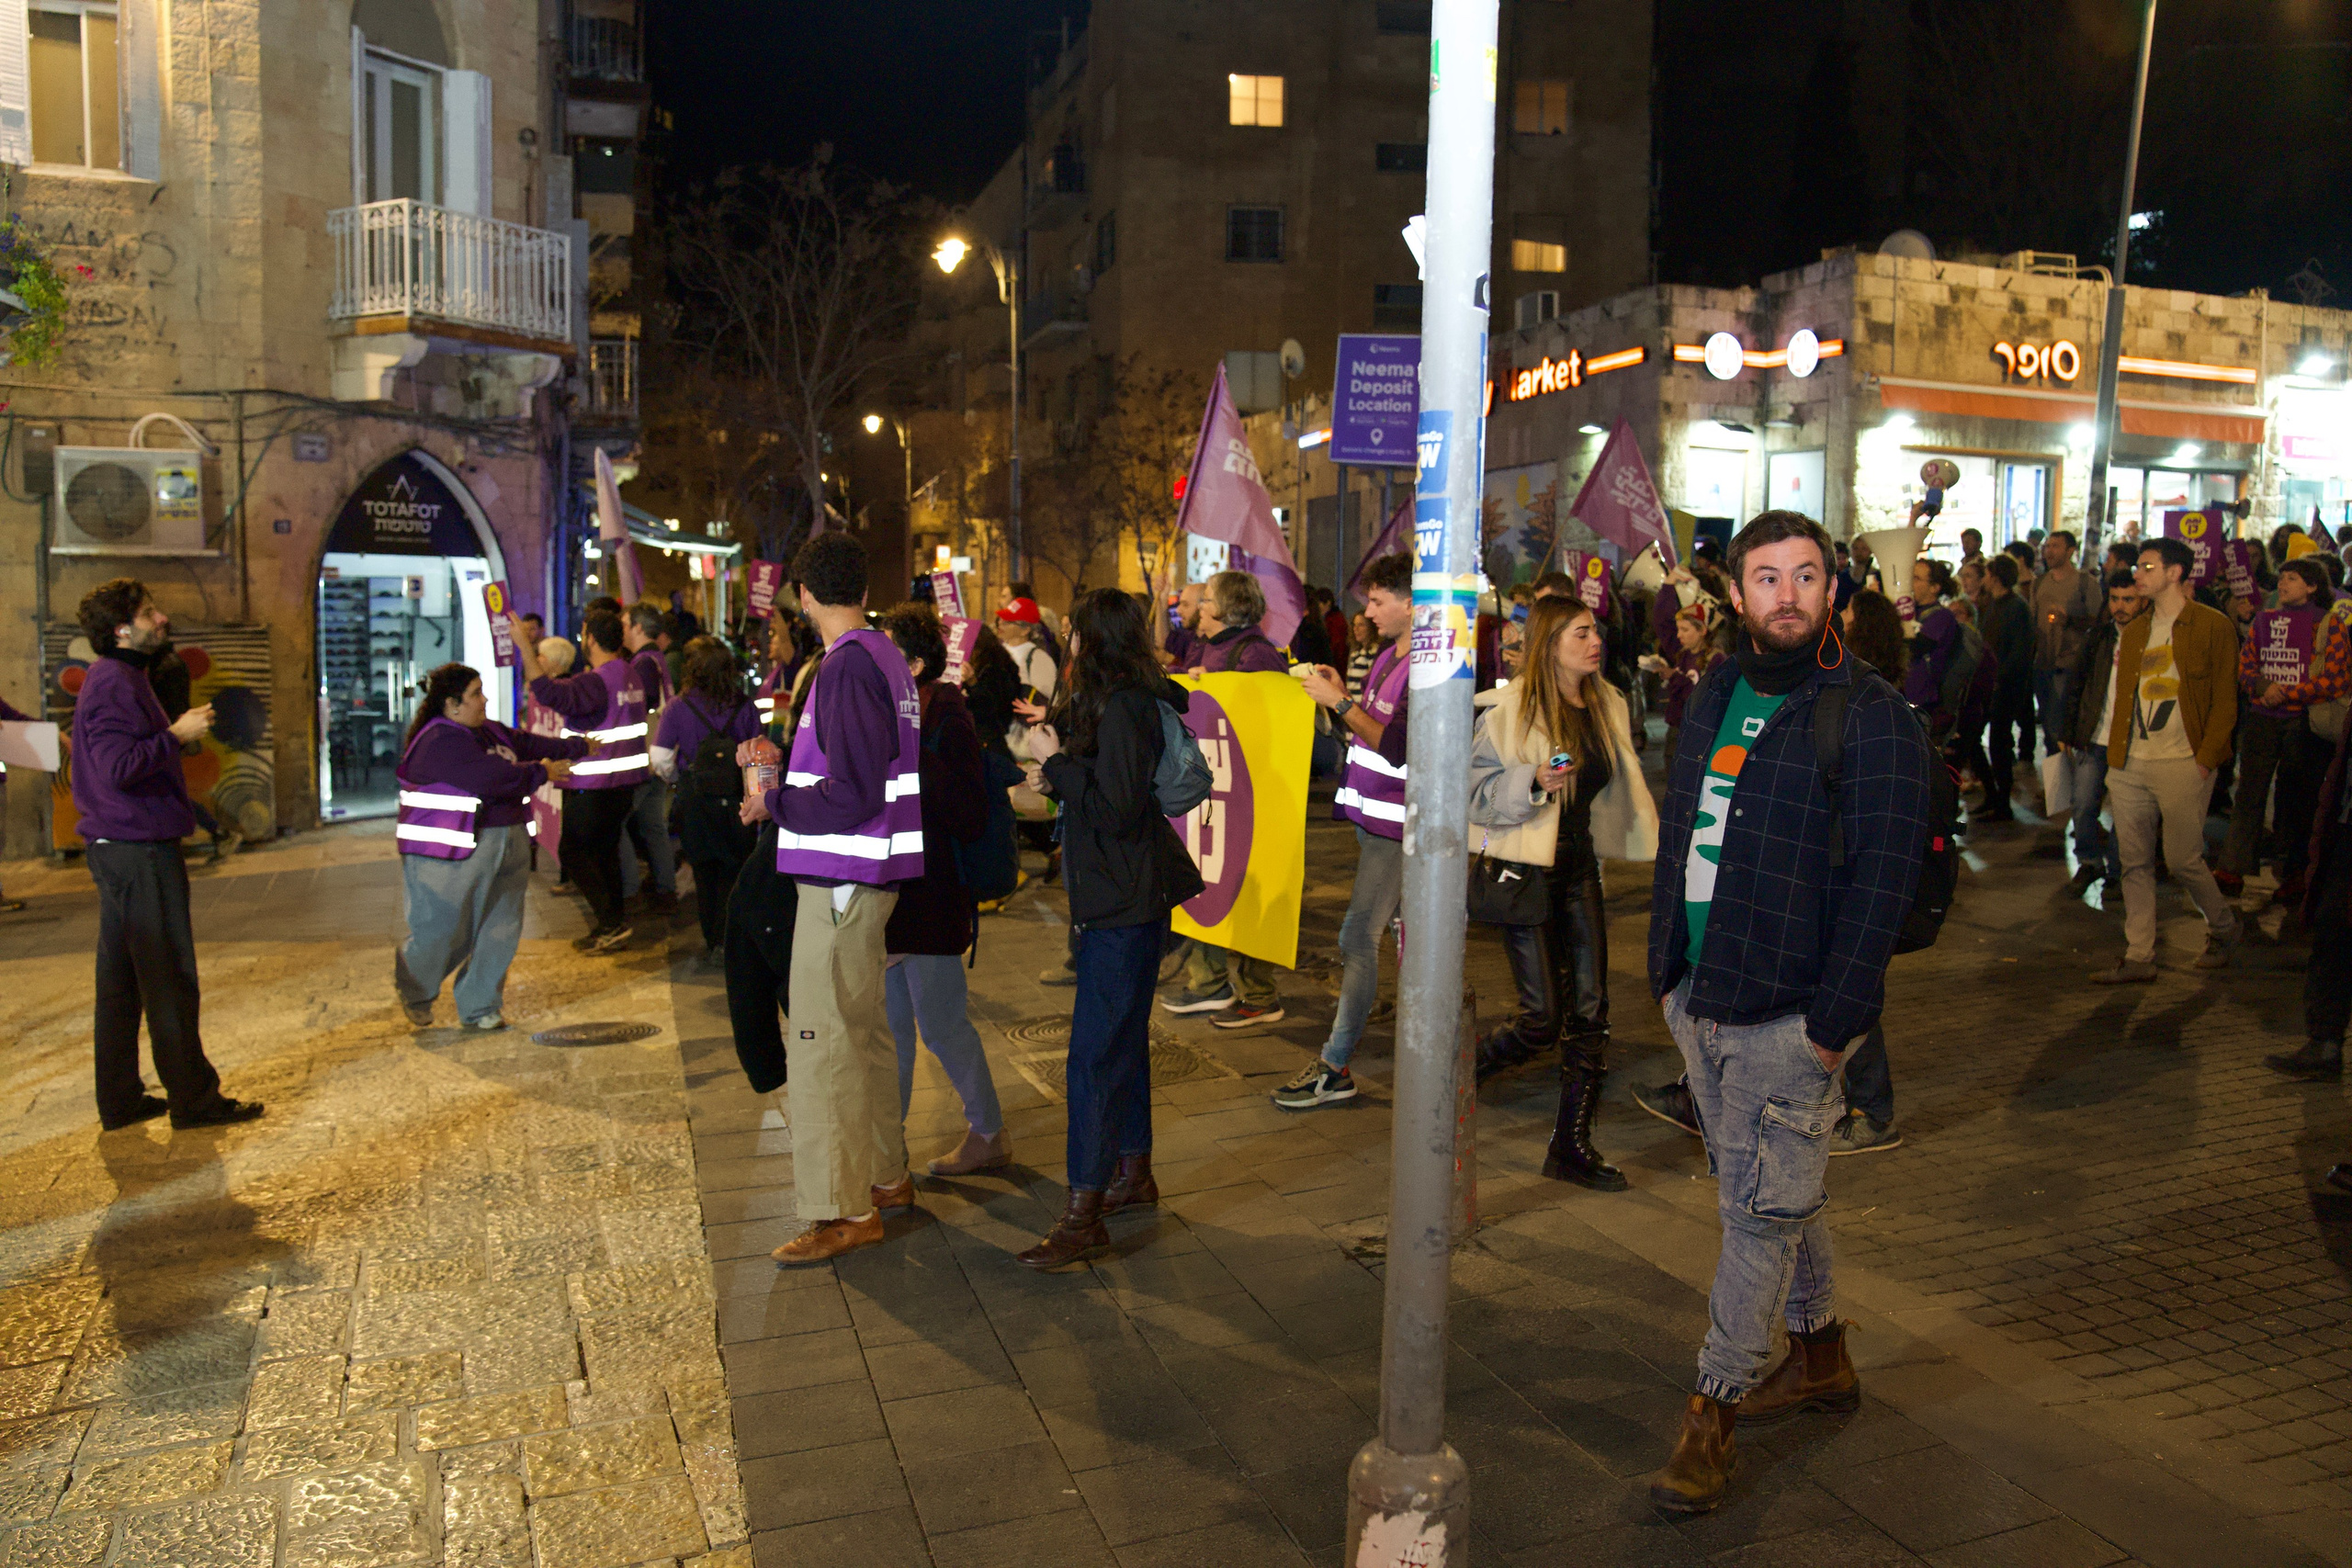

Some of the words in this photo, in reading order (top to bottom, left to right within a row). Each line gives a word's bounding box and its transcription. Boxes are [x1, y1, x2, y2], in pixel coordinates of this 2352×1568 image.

[1351, 360, 1415, 378] Neema
[1993, 339, 2082, 382] סופר
[1350, 378, 1414, 397] Deposit
[1348, 397, 1412, 412] Location
[362, 500, 441, 519] TOTAFOT
